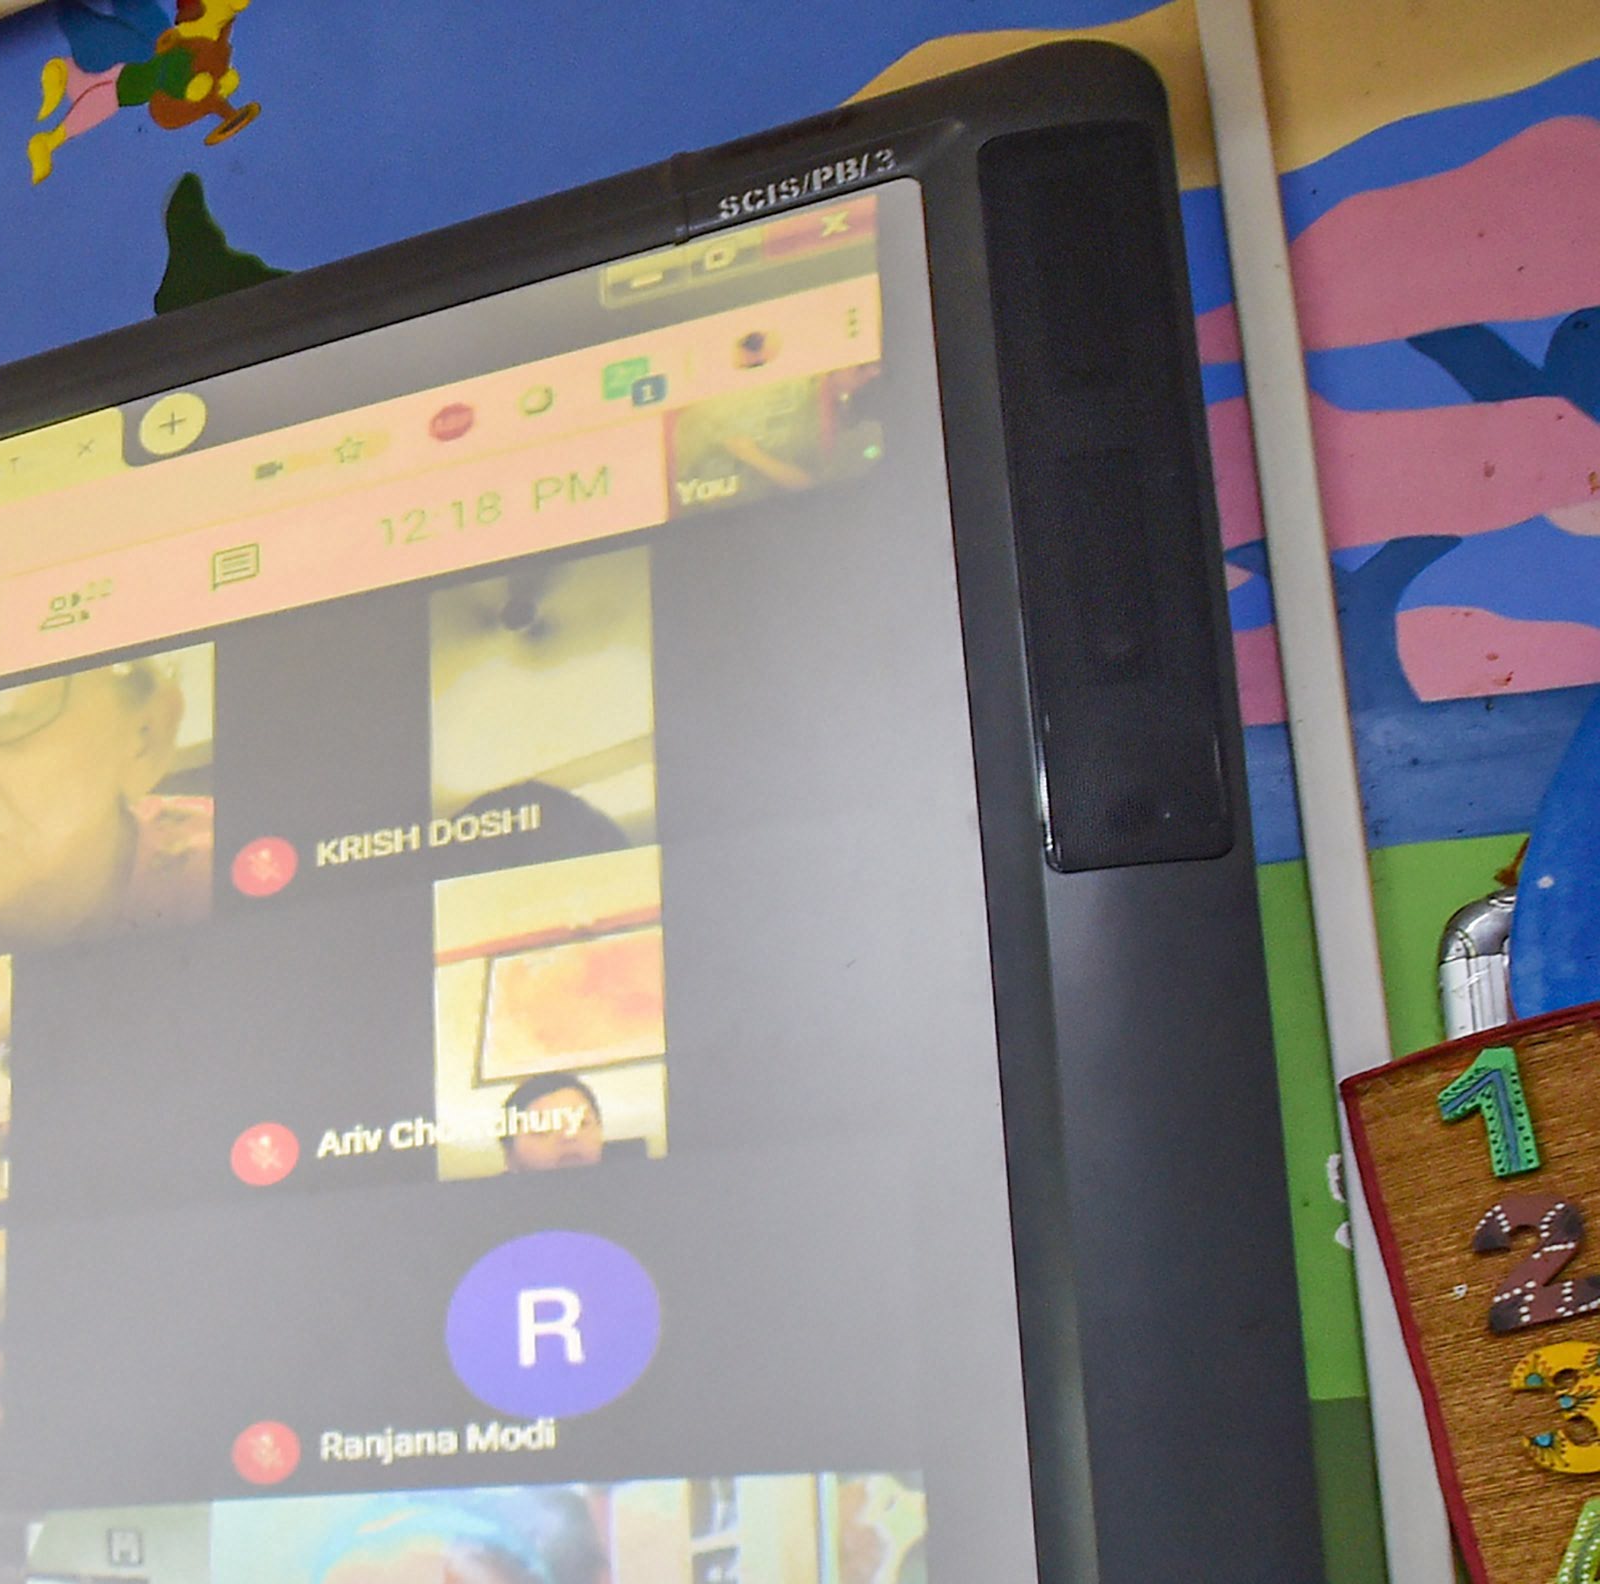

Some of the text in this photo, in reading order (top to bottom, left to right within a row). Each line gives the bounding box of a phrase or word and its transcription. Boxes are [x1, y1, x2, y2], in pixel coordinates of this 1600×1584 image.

[375, 463, 612, 550] 12:18 PM
[675, 473, 738, 504] You
[315, 802, 542, 867] KRISH DOSHI
[316, 1101, 586, 1160] Ariv Chdhury
[1437, 1046, 1541, 1177] 1
[1471, 1196, 1600, 1334] 2
[515, 1286, 587, 1369] R
[318, 1417, 557, 1465] Ranjana Modi
